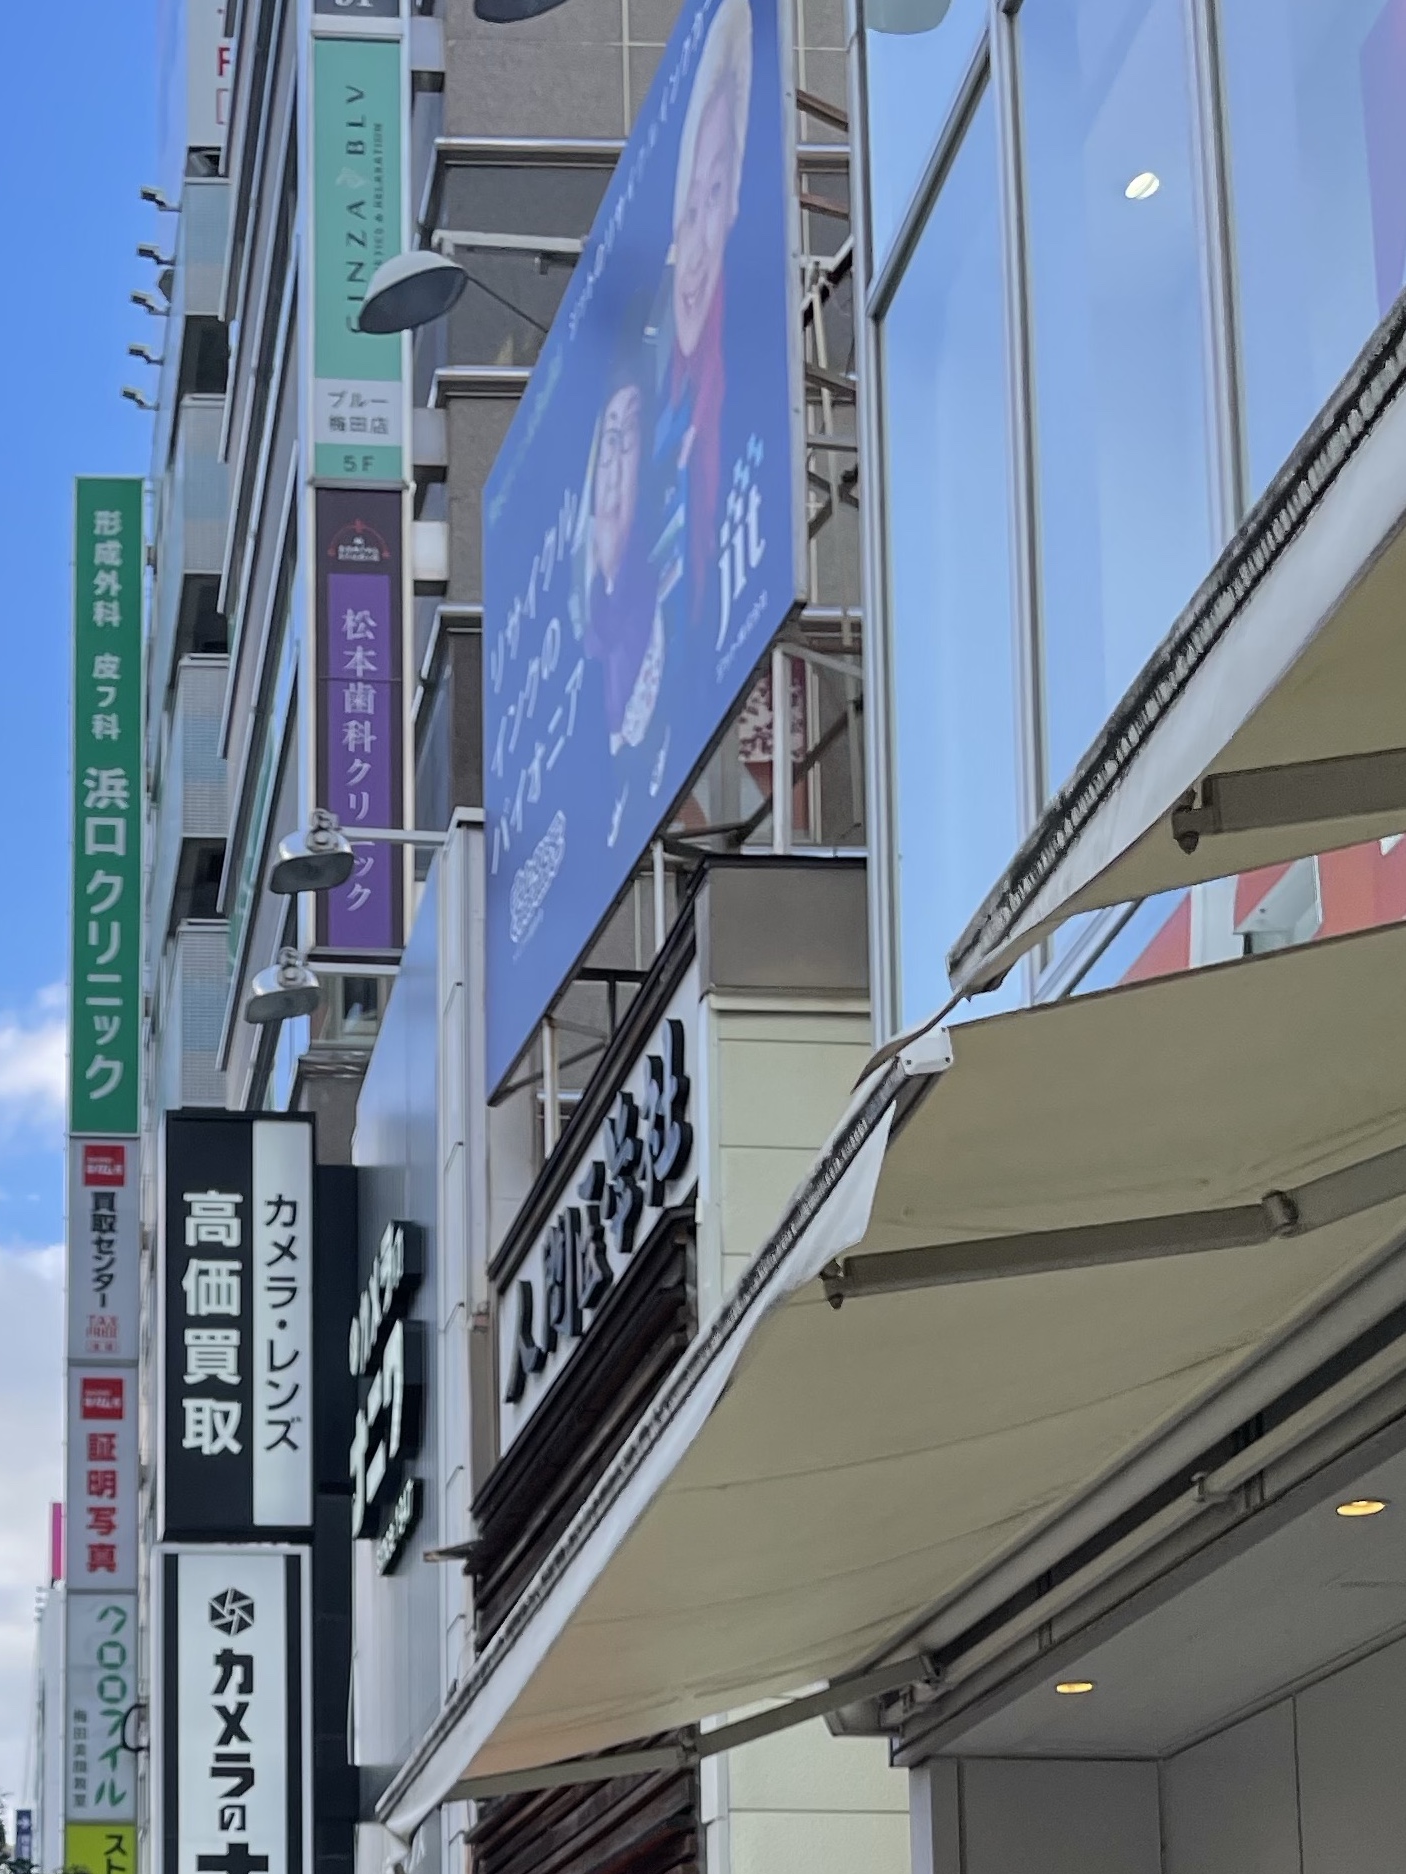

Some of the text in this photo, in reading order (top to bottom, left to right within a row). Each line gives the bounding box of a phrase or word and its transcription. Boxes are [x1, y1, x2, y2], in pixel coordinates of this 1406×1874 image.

[328, 391, 390, 409] ブルー
[343, 455, 376, 472] 5F
[91, 510, 123, 742] 形成外科 皮フ科
[491, 487, 579, 694] リサイクル
[715, 482, 766, 652] jit
[491, 657, 584, 876] パイオニア
[492, 617, 562, 779] インクの
[83, 766, 131, 1101] 浜口クリニック
[90, 1191, 117, 1309] 買取センター
[181, 1190, 244, 1456] 高価買取
[263, 1194, 303, 1453] カメラ・レンズ
[86, 1432, 118, 1574] 証明写真
[348, 1316, 406, 1540] ナニワ
